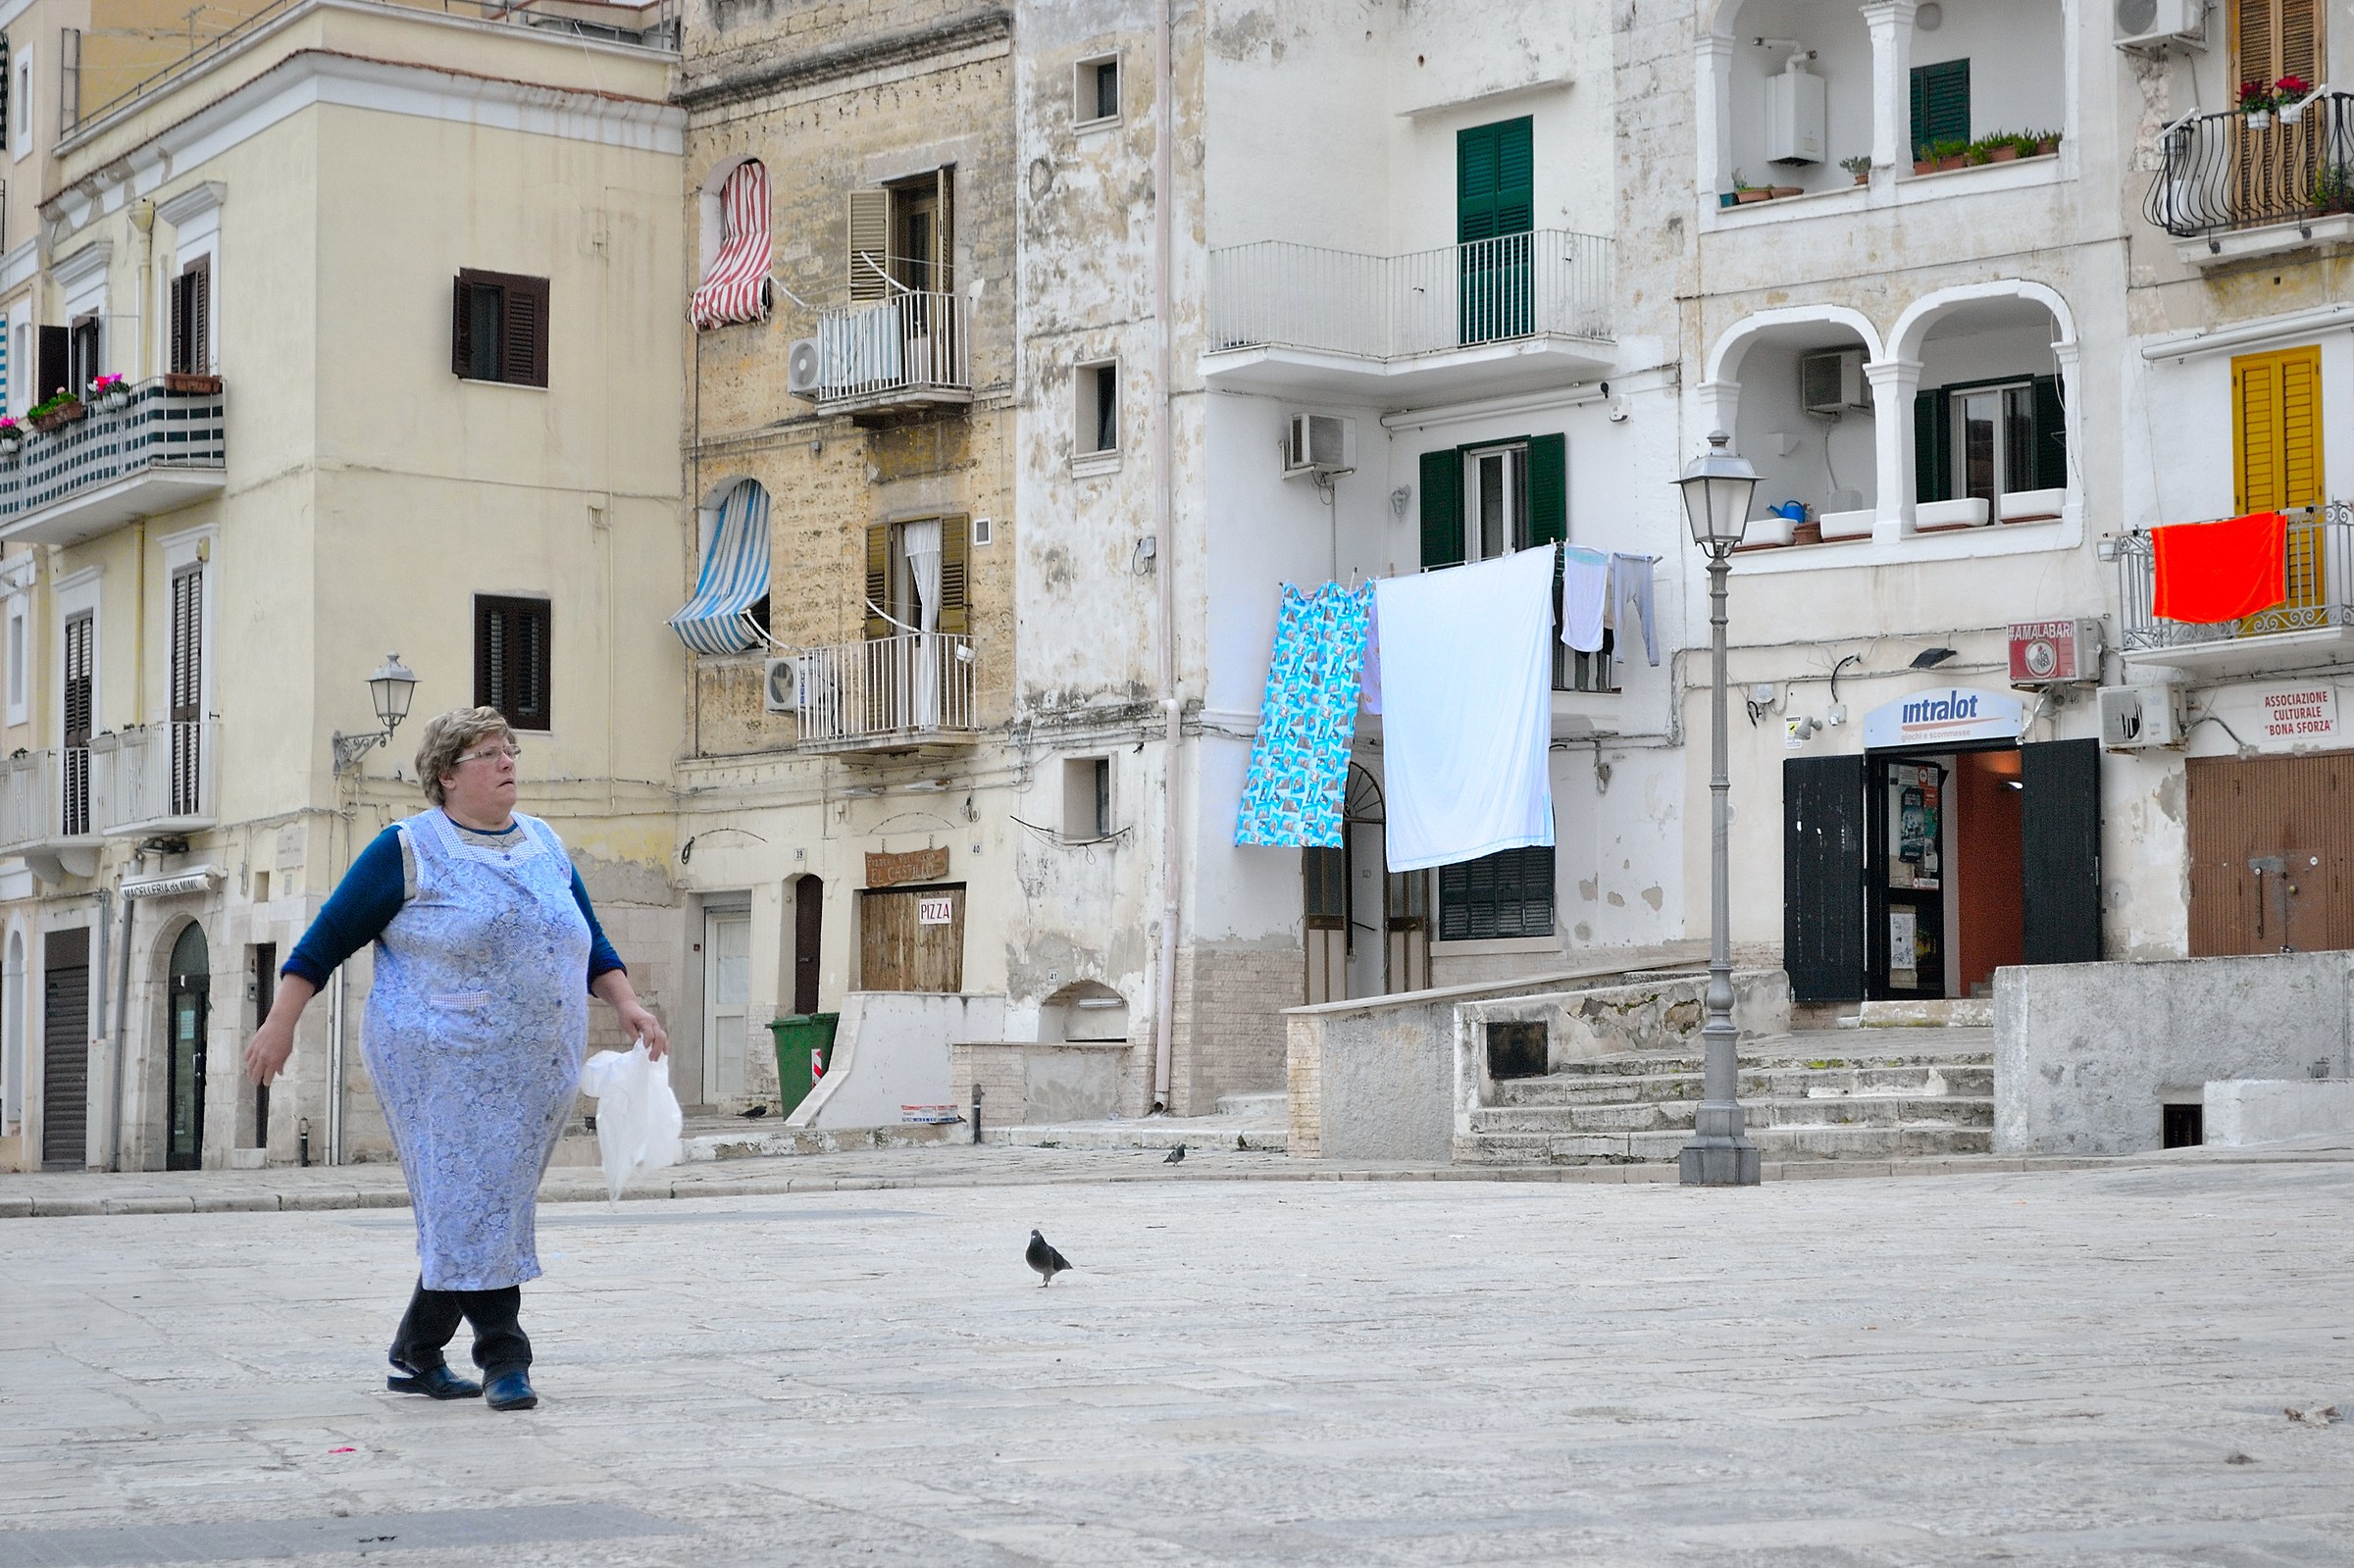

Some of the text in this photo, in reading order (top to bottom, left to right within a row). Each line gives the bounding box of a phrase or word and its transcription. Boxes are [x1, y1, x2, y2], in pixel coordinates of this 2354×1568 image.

[2265, 691, 2328, 707] ASSOCIAZIONE
[1902, 690, 1978, 723] intralot
[2274, 707, 2322, 721] CULTURALE
[1902, 732, 1921, 742] giochi
[1929, 730, 1970, 738] scommesse
[972, 844, 981, 854] 40
[125, 884, 171, 898] MACELLERIA
[921, 903, 949, 920] PIZZA
